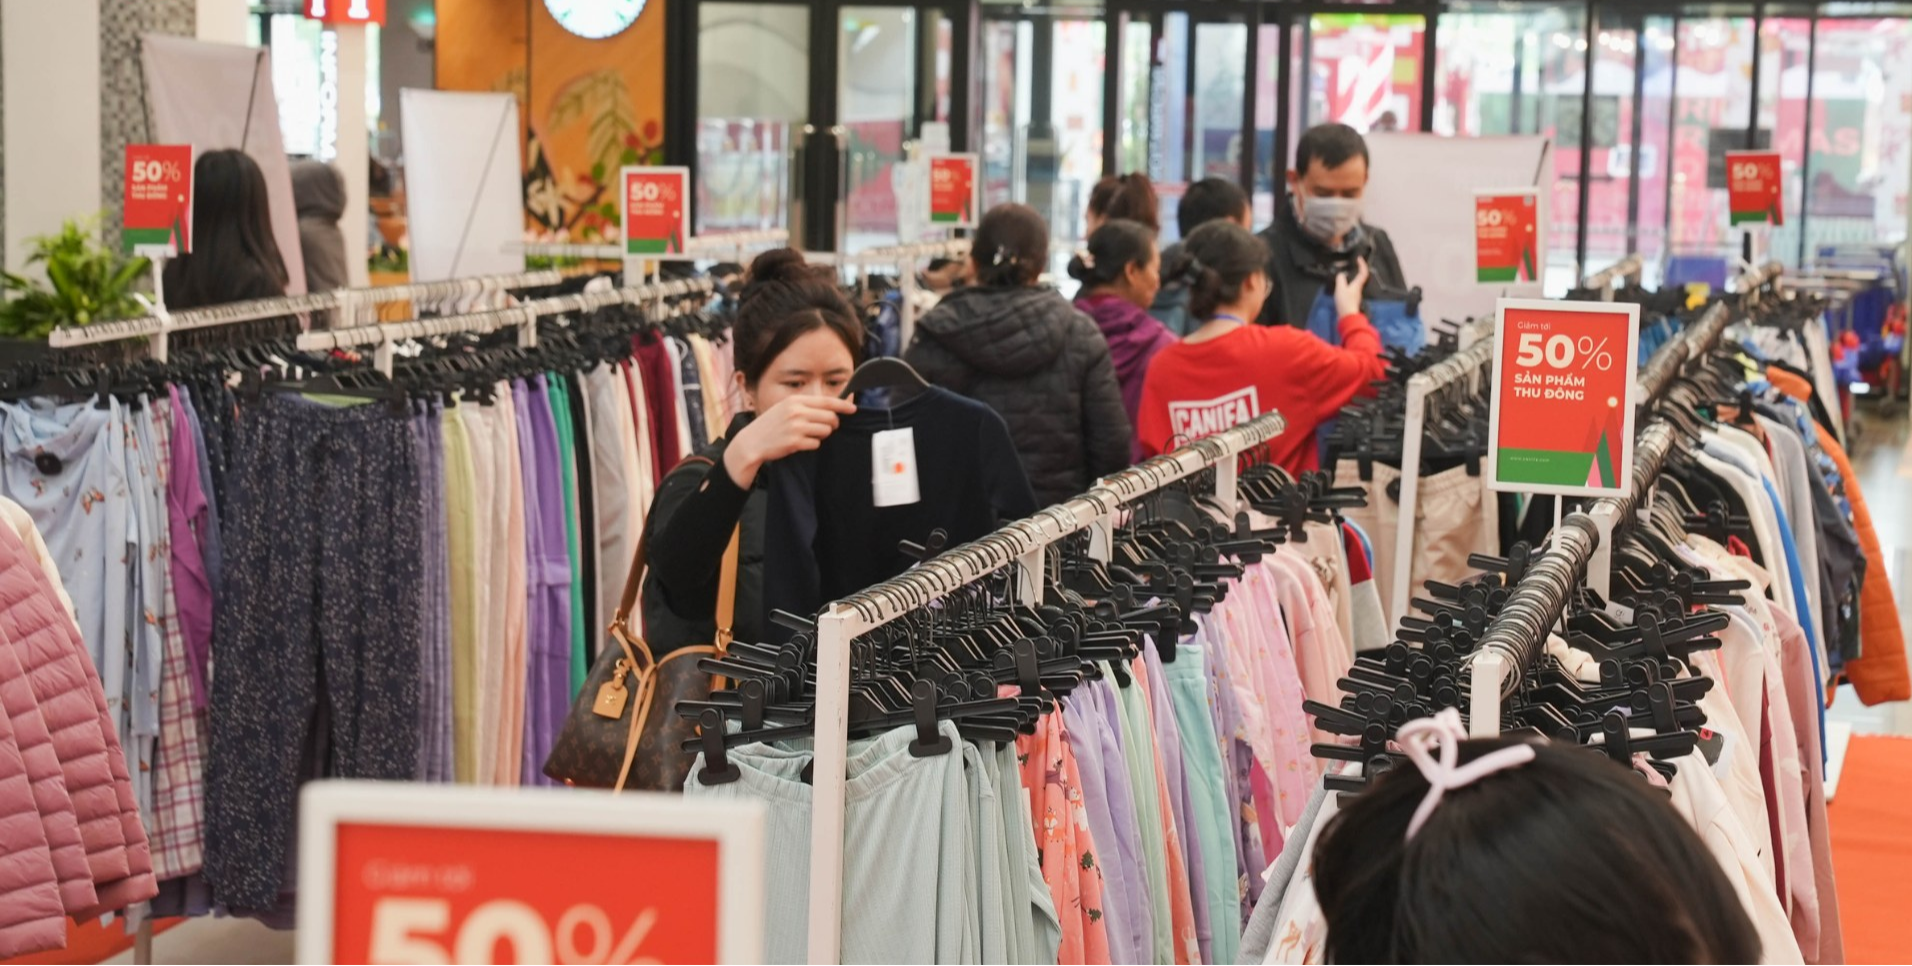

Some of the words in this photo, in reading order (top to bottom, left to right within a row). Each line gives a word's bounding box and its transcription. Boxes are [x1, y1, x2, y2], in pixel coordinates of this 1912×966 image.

[132, 160, 182, 183] 50%
[630, 182, 677, 201] 50%
[1517, 321, 1539, 330] Giảm
[1515, 333, 1612, 371] 50%
[1514, 371, 1542, 384] SẢN
[1545, 372, 1586, 387] PHẨM
[1514, 387, 1541, 398] THU
[1544, 387, 1585, 401] ĐÔNG
[1175, 397, 1251, 438] CANIFA
[368, 896, 668, 964] 50%
